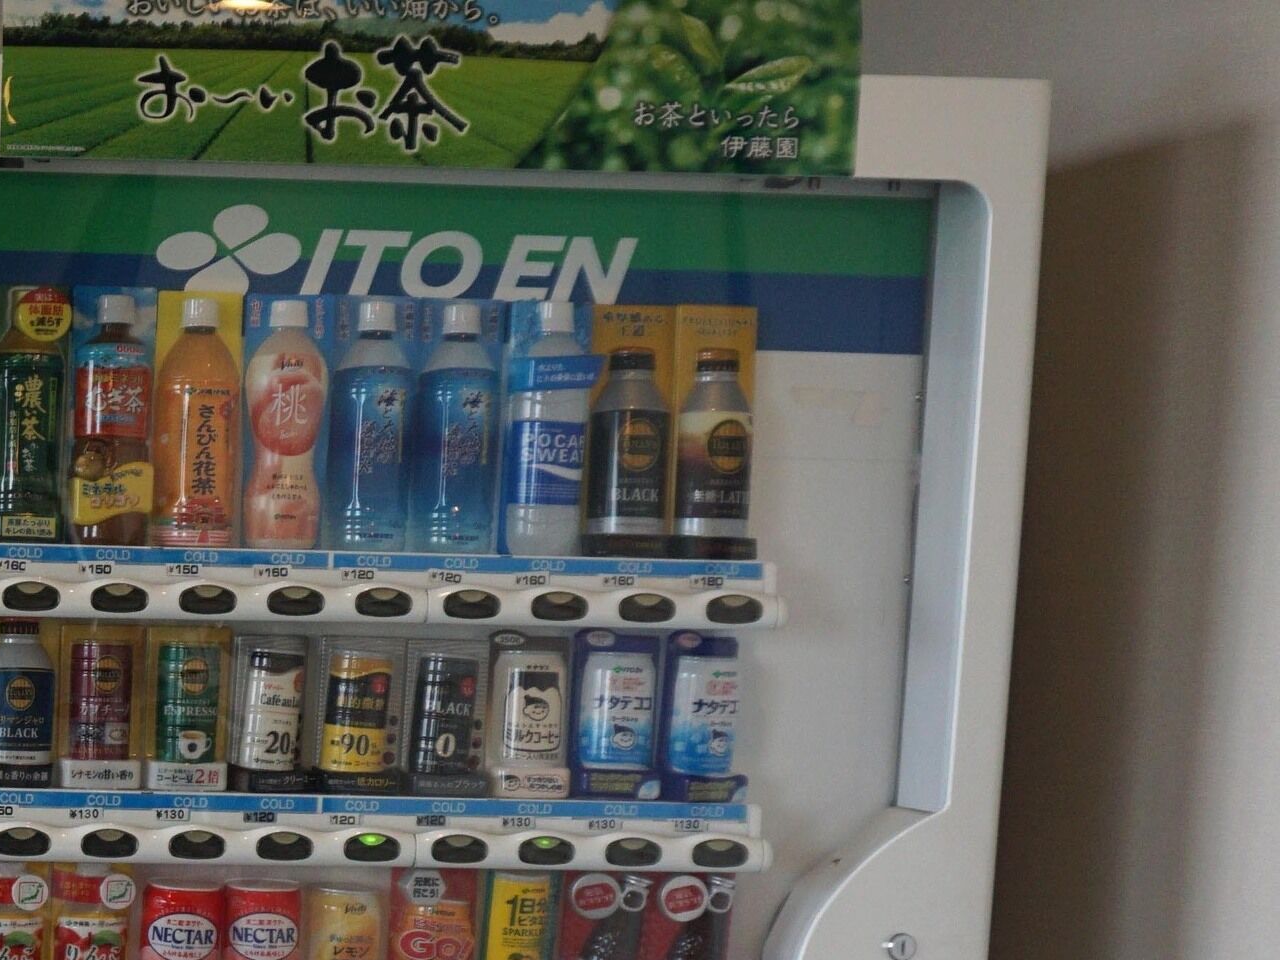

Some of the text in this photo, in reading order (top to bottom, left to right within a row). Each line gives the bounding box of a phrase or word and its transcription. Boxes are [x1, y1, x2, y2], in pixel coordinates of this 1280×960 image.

[633, 101, 800, 129] お茶といったら
[720, 135, 799, 159] 伊藤園
[289, 228, 639, 306] ITO EN
[272, 383, 308, 426] 桃
[8, 547, 42, 559] COLD
[96, 549, 130, 561] COLD
[184, 551, 218, 563] COLD
[271, 552, 306, 564] COLD
[356, 555, 392, 567] COLD
[444, 557, 479, 570] COLD
[531, 559, 566, 572] COLD
[618, 561, 653, 573] COLD
[81, 564, 112, 575] ¥150
[169, 564, 199, 575] ¥150
[343, 568, 375, 580] ¥120
[705, 563, 740, 575] COLD
[266, 730, 290, 754] 20
[341, 733, 370, 756] 90
[0, 792, 34, 804] COLD
[86, 794, 121, 807] COLD
[173, 796, 208, 808] COLD
[260, 798, 294, 810] COLD
[345, 800, 380, 812] COLD
[431, 801, 466, 814] COLD
[518, 803, 553, 815] COLD
[604, 804, 638, 816] COLD
[690, 806, 724, 818] COLD
[70, 808, 100, 819] ¥130
[156, 808, 186, 820] ¥130
[502, 816, 531, 828] ¥130
[151, 926, 214, 944] NECTAR
[232, 926, 295, 943] NECTAR
[333, 944, 370, 957] レモン
